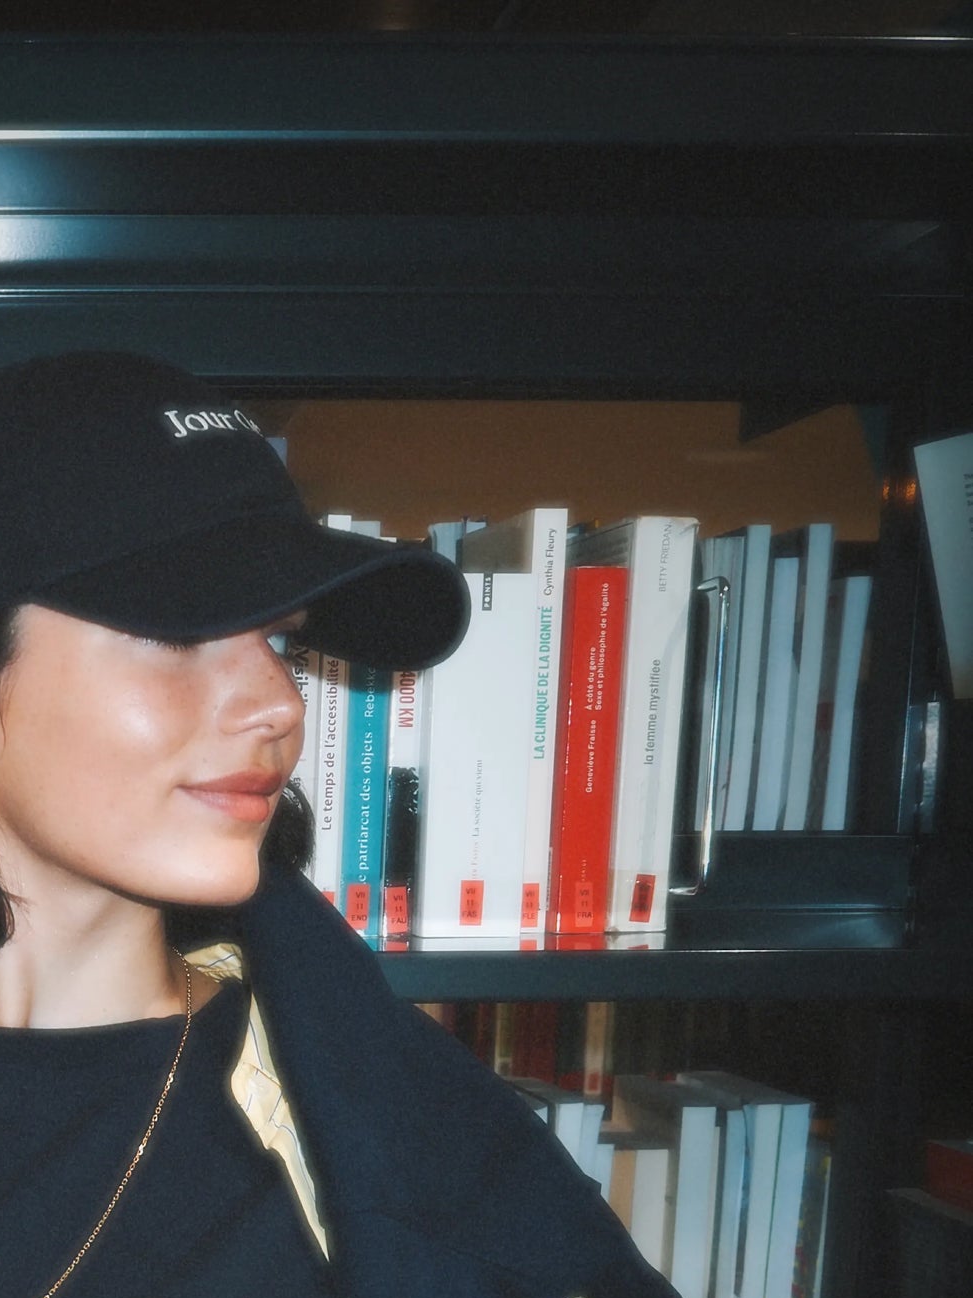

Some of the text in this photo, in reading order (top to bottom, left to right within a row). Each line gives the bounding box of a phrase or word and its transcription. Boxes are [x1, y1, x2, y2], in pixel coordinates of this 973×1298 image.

[164, 410, 237, 438] Jour
[543, 527, 556, 596] Cynthia Fleury
[483, 577, 491, 608] POINTS
[658, 567, 667, 592] BETTY
[600, 618, 607, 628] de
[589, 647, 597, 671] genre
[596, 630, 607, 678] philosophie
[533, 606, 553, 760] LA CLINIQUE DE LA DIGNITÉ
[587, 672, 594, 683] du
[596, 680, 603, 689] et
[398, 708, 414, 728] KM
[321, 659, 339, 830] Le temps de l'accessibilité
[587, 719, 596, 749] Fraisse
[643, 713, 657, 765] la femme
[361, 731, 374, 773] objets
[475, 759, 483, 781] vient
[360, 778, 371, 801] des
[475, 782, 483, 796] qui
[358, 805, 370, 871] patriarcat
[462, 910, 478, 918] FAS
